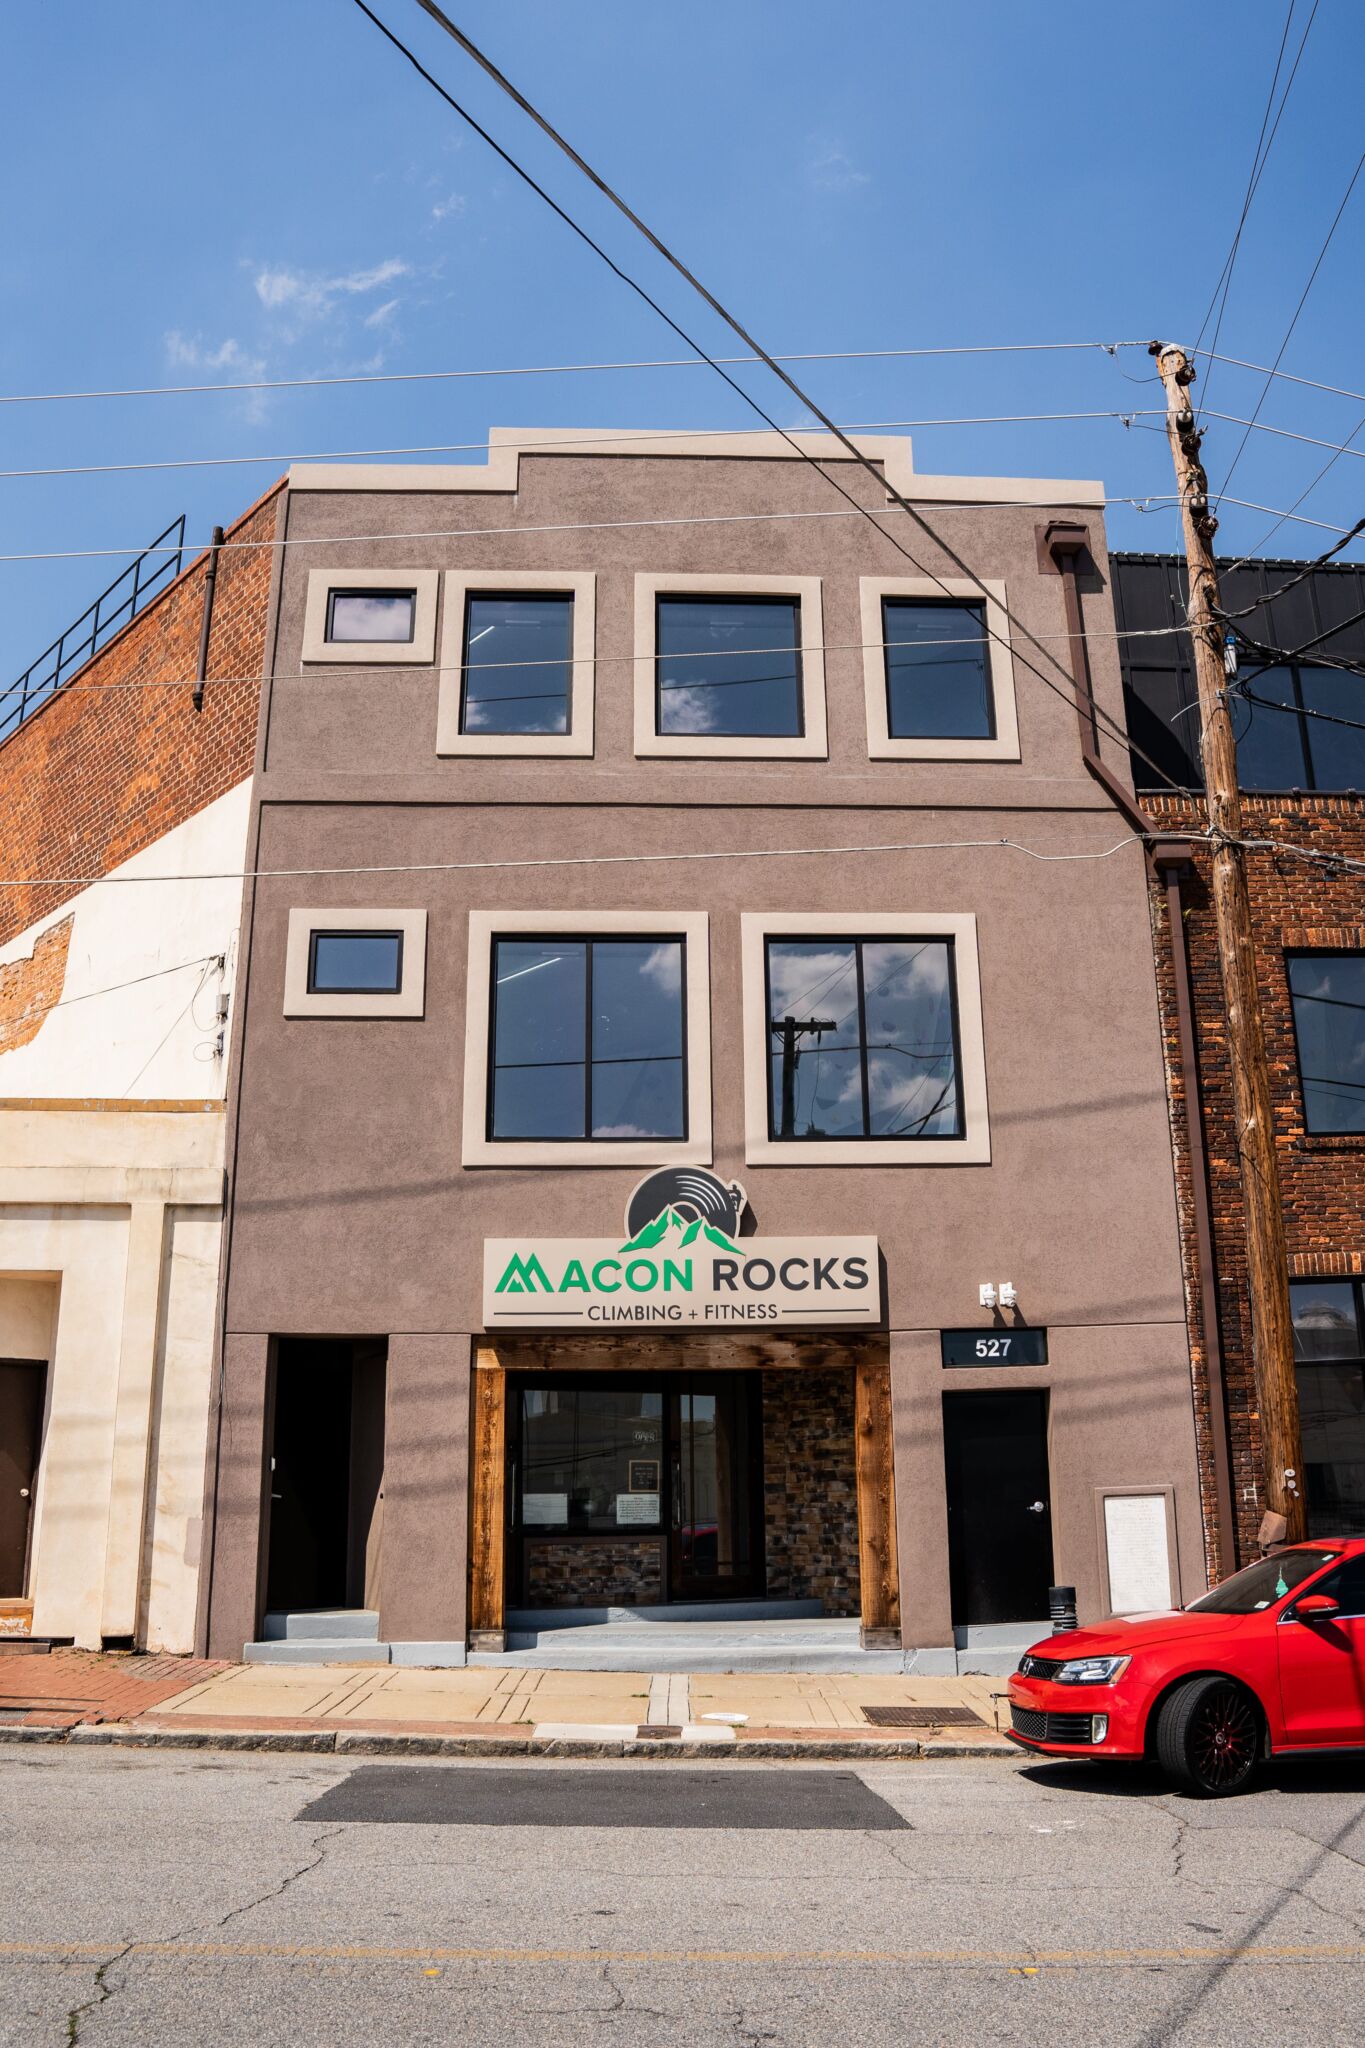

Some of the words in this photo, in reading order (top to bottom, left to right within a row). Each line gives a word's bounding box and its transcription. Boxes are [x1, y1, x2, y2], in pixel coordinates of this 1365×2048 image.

[494, 1252, 693, 1293] MACON
[713, 1256, 869, 1292] ROCKS
[588, 1304, 682, 1321] CLIMBING
[704, 1303, 778, 1320] FITNESS
[975, 1339, 1012, 1357] 527
